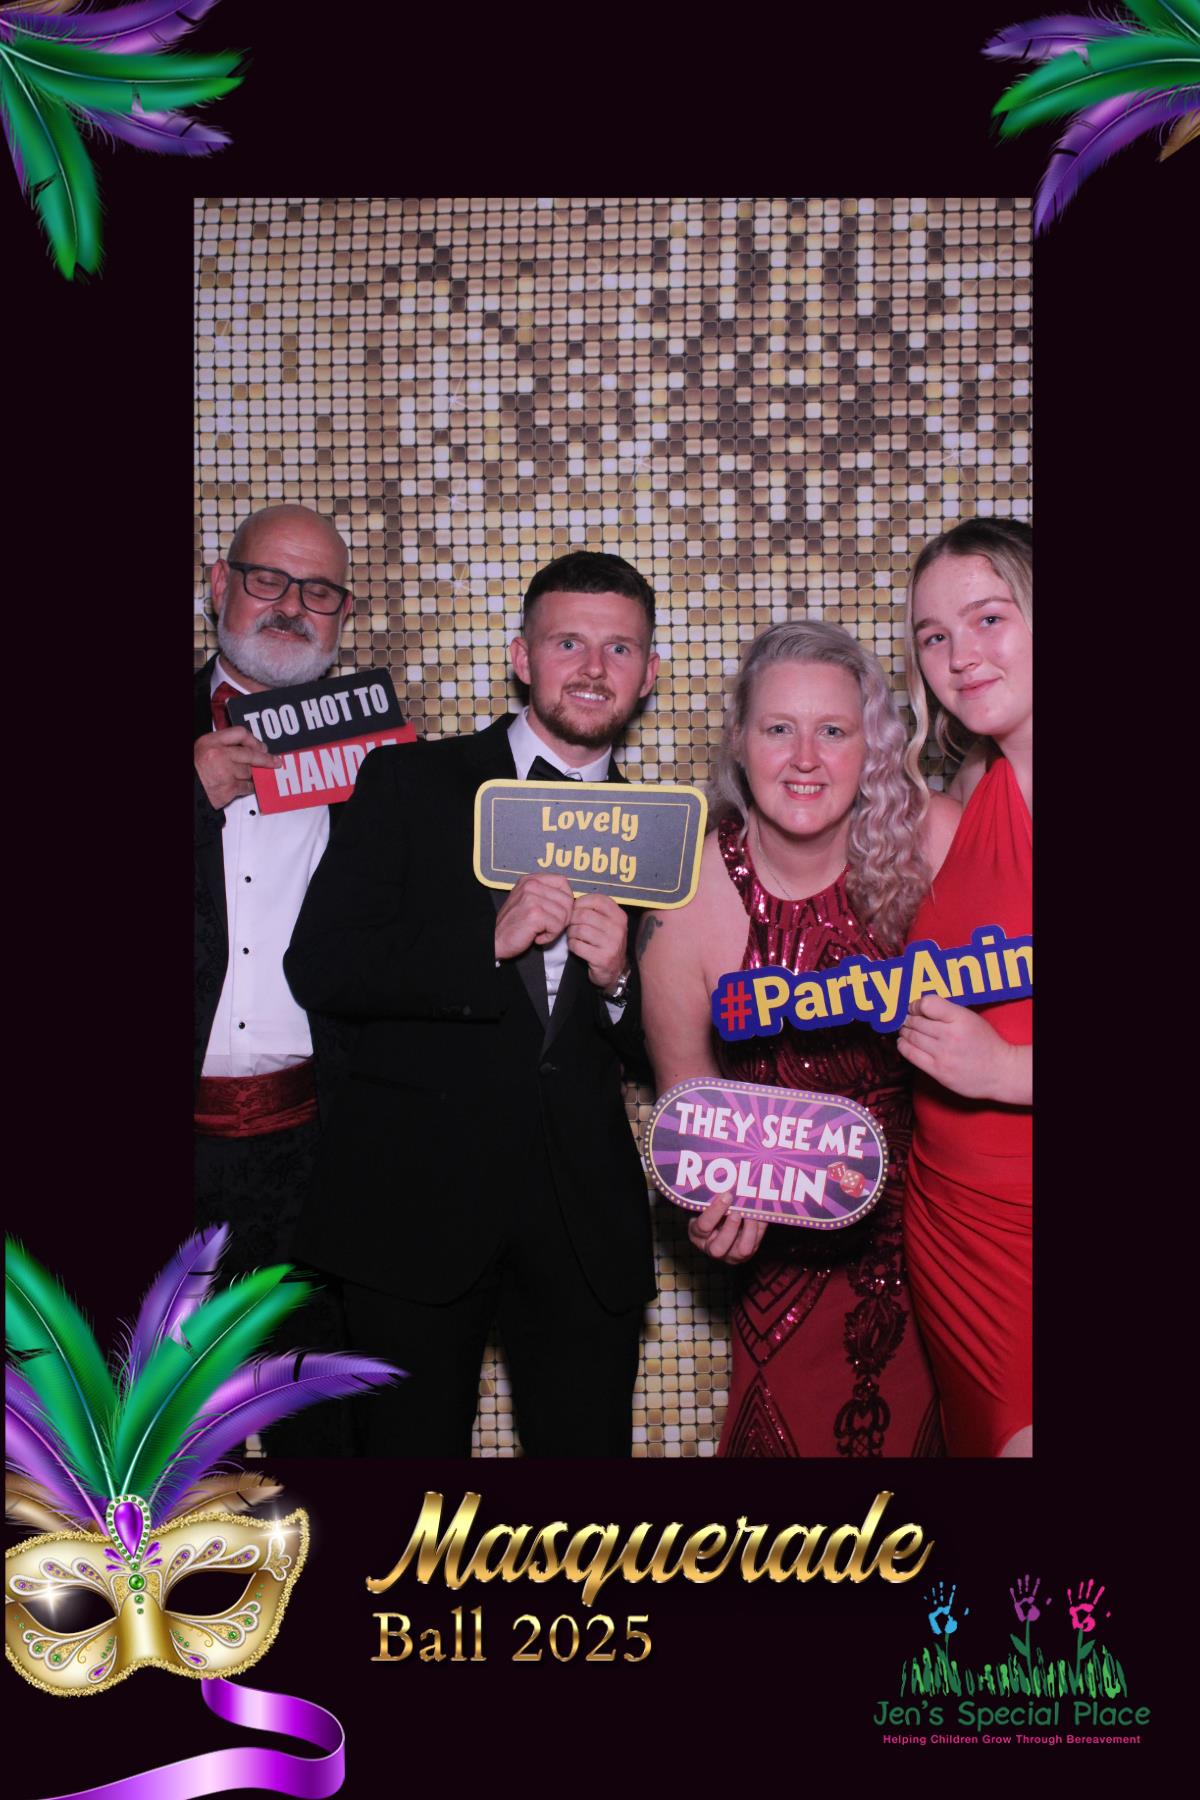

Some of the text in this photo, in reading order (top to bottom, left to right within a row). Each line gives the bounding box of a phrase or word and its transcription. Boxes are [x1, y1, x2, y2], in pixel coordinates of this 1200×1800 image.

[244, 684, 390, 743] TOO HOT TO
[541, 806, 640, 842] Lovely
[536, 842, 637, 883] Jubbly
[676, 1102, 867, 1160] THEY SEE ME
[675, 1150, 829, 1206] ROLLIN
